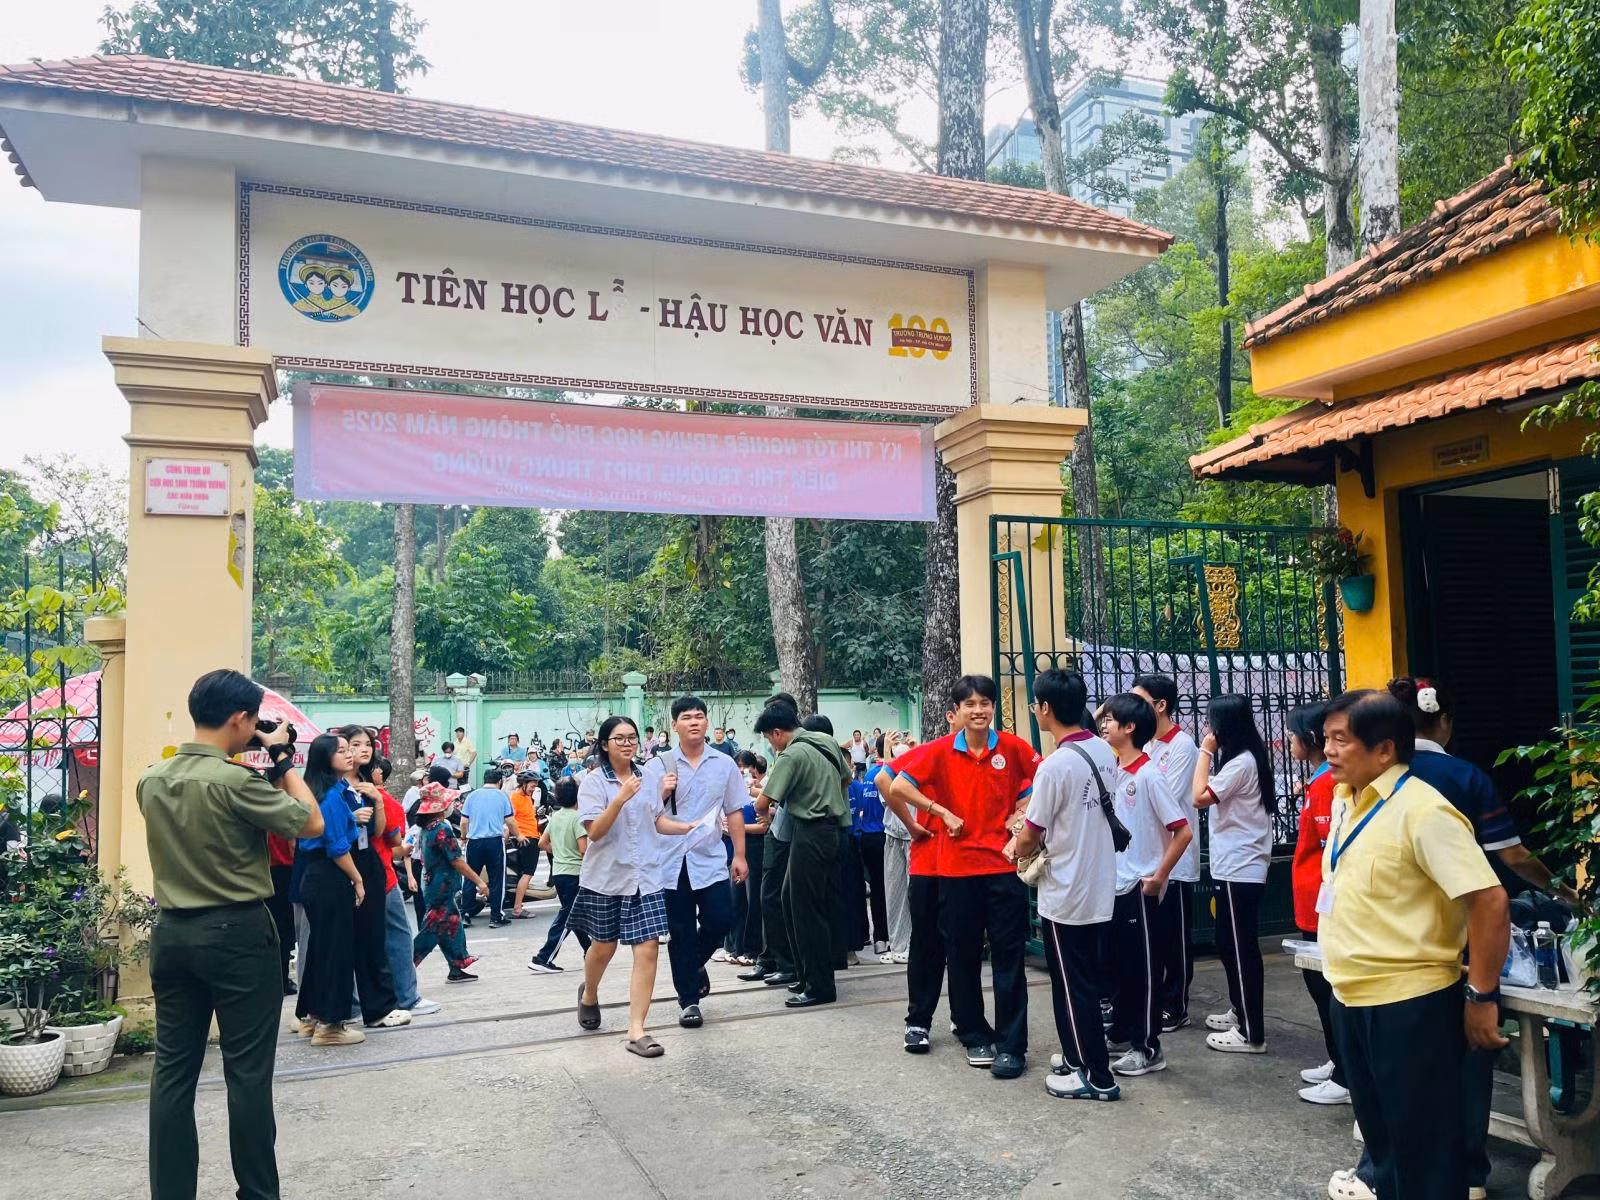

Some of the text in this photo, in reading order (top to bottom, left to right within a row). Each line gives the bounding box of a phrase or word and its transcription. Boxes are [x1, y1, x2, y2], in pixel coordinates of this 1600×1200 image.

[396, 267, 488, 310] TIÊN
[501, 282, 576, 324] HỌC
[658, 293, 728, 339] HẬU
[739, 306, 804, 346] HỌC
[813, 307, 873, 346] VĂN
[888, 313, 950, 361] 100
[396, 758, 408, 766] 42
